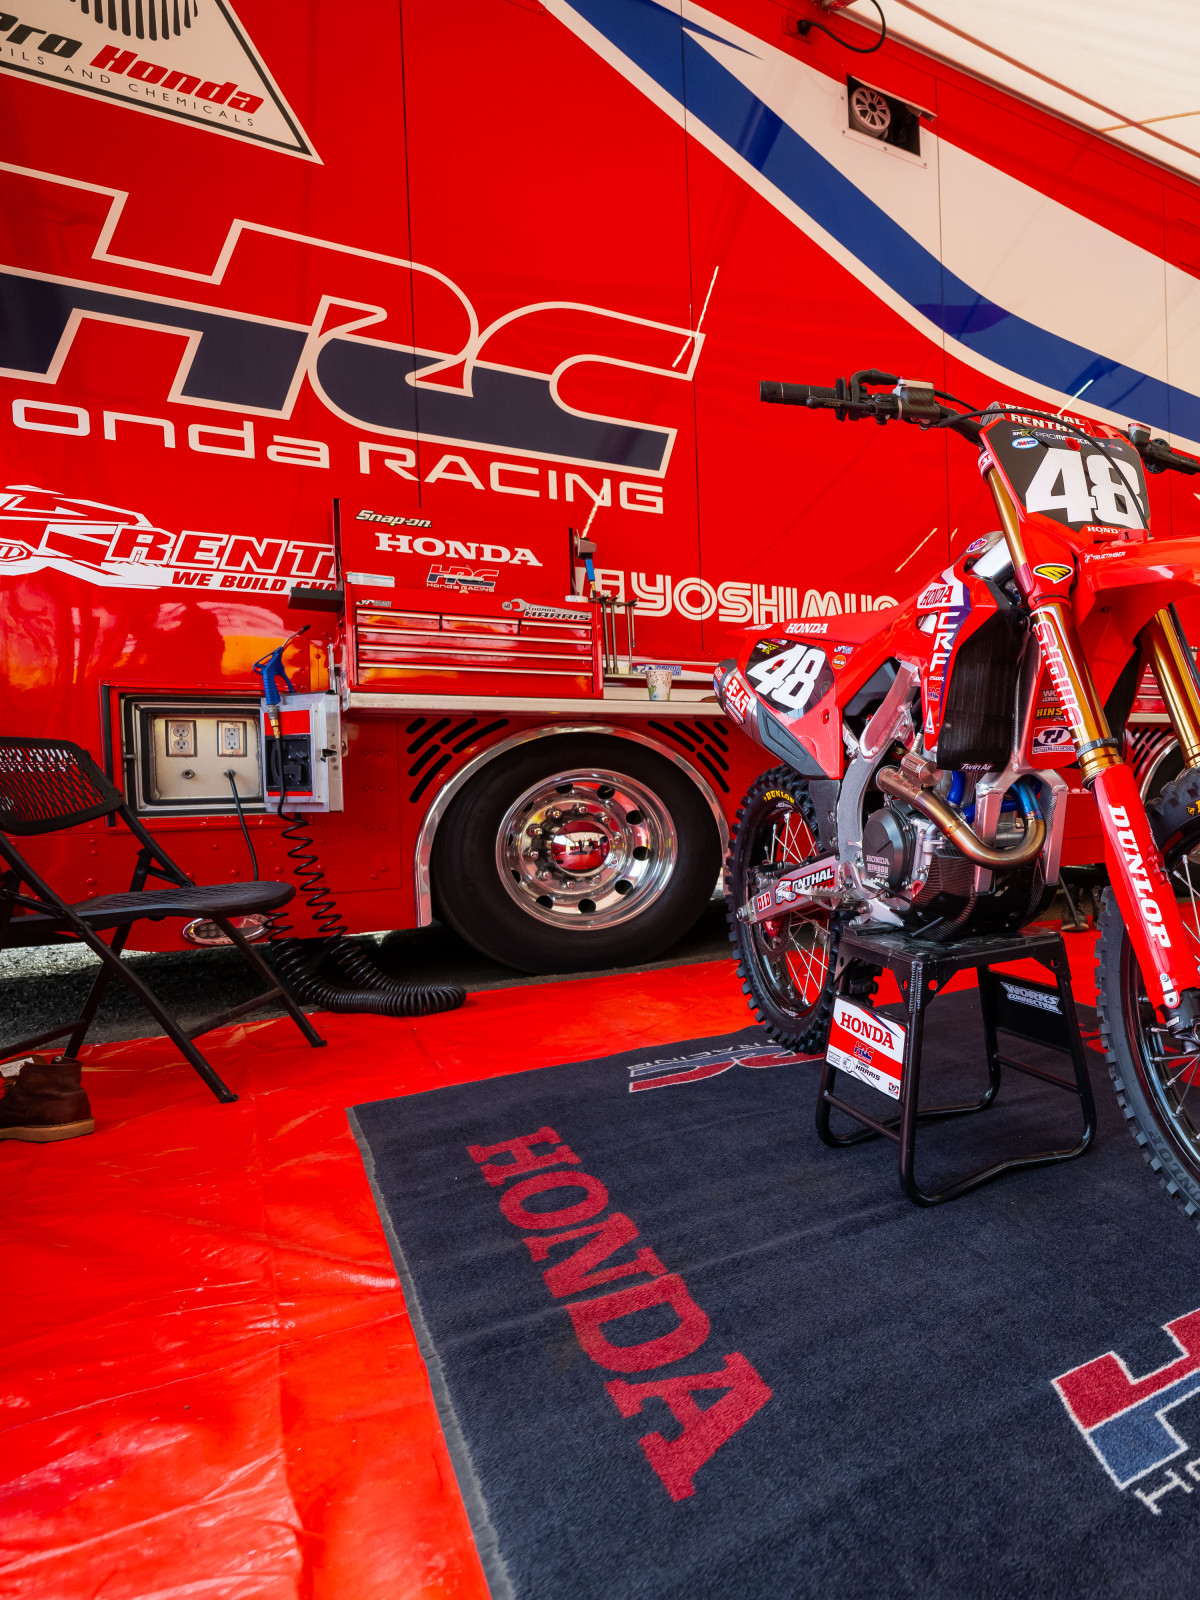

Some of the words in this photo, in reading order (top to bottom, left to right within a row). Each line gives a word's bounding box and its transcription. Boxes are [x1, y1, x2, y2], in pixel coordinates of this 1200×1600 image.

[0, 45, 46, 66] ILS
[63, 64, 111, 84] AND
[128, 82, 255, 127] CHEMICALS
[89, 44, 264, 115] Honda
[11, 398, 330, 470] onda
[358, 440, 665, 515] RACING
[1025, 448, 1149, 530] 48
[355, 509, 432, 529] Snap-on
[103, 523, 336, 578] RENT
[374, 532, 543, 567] HONDA
[172, 571, 212, 585] WE
[219, 574, 288, 592] BUILD
[426, 563, 500, 588] HRC
[918, 585, 954, 607] HONDA
[524, 611, 592, 621] HARRIS
[785, 623, 829, 634] HONDA
[747, 643, 827, 710] 48
[1036, 707, 1063, 717] HINS
[961, 763, 980, 771] Twin
[1108, 804, 1172, 948] DUNLOP
[840, 1011, 895, 1051] HONDA
[855, 1064, 881, 1081] HARRIS
[466, 1125, 773, 1503] HONDA
